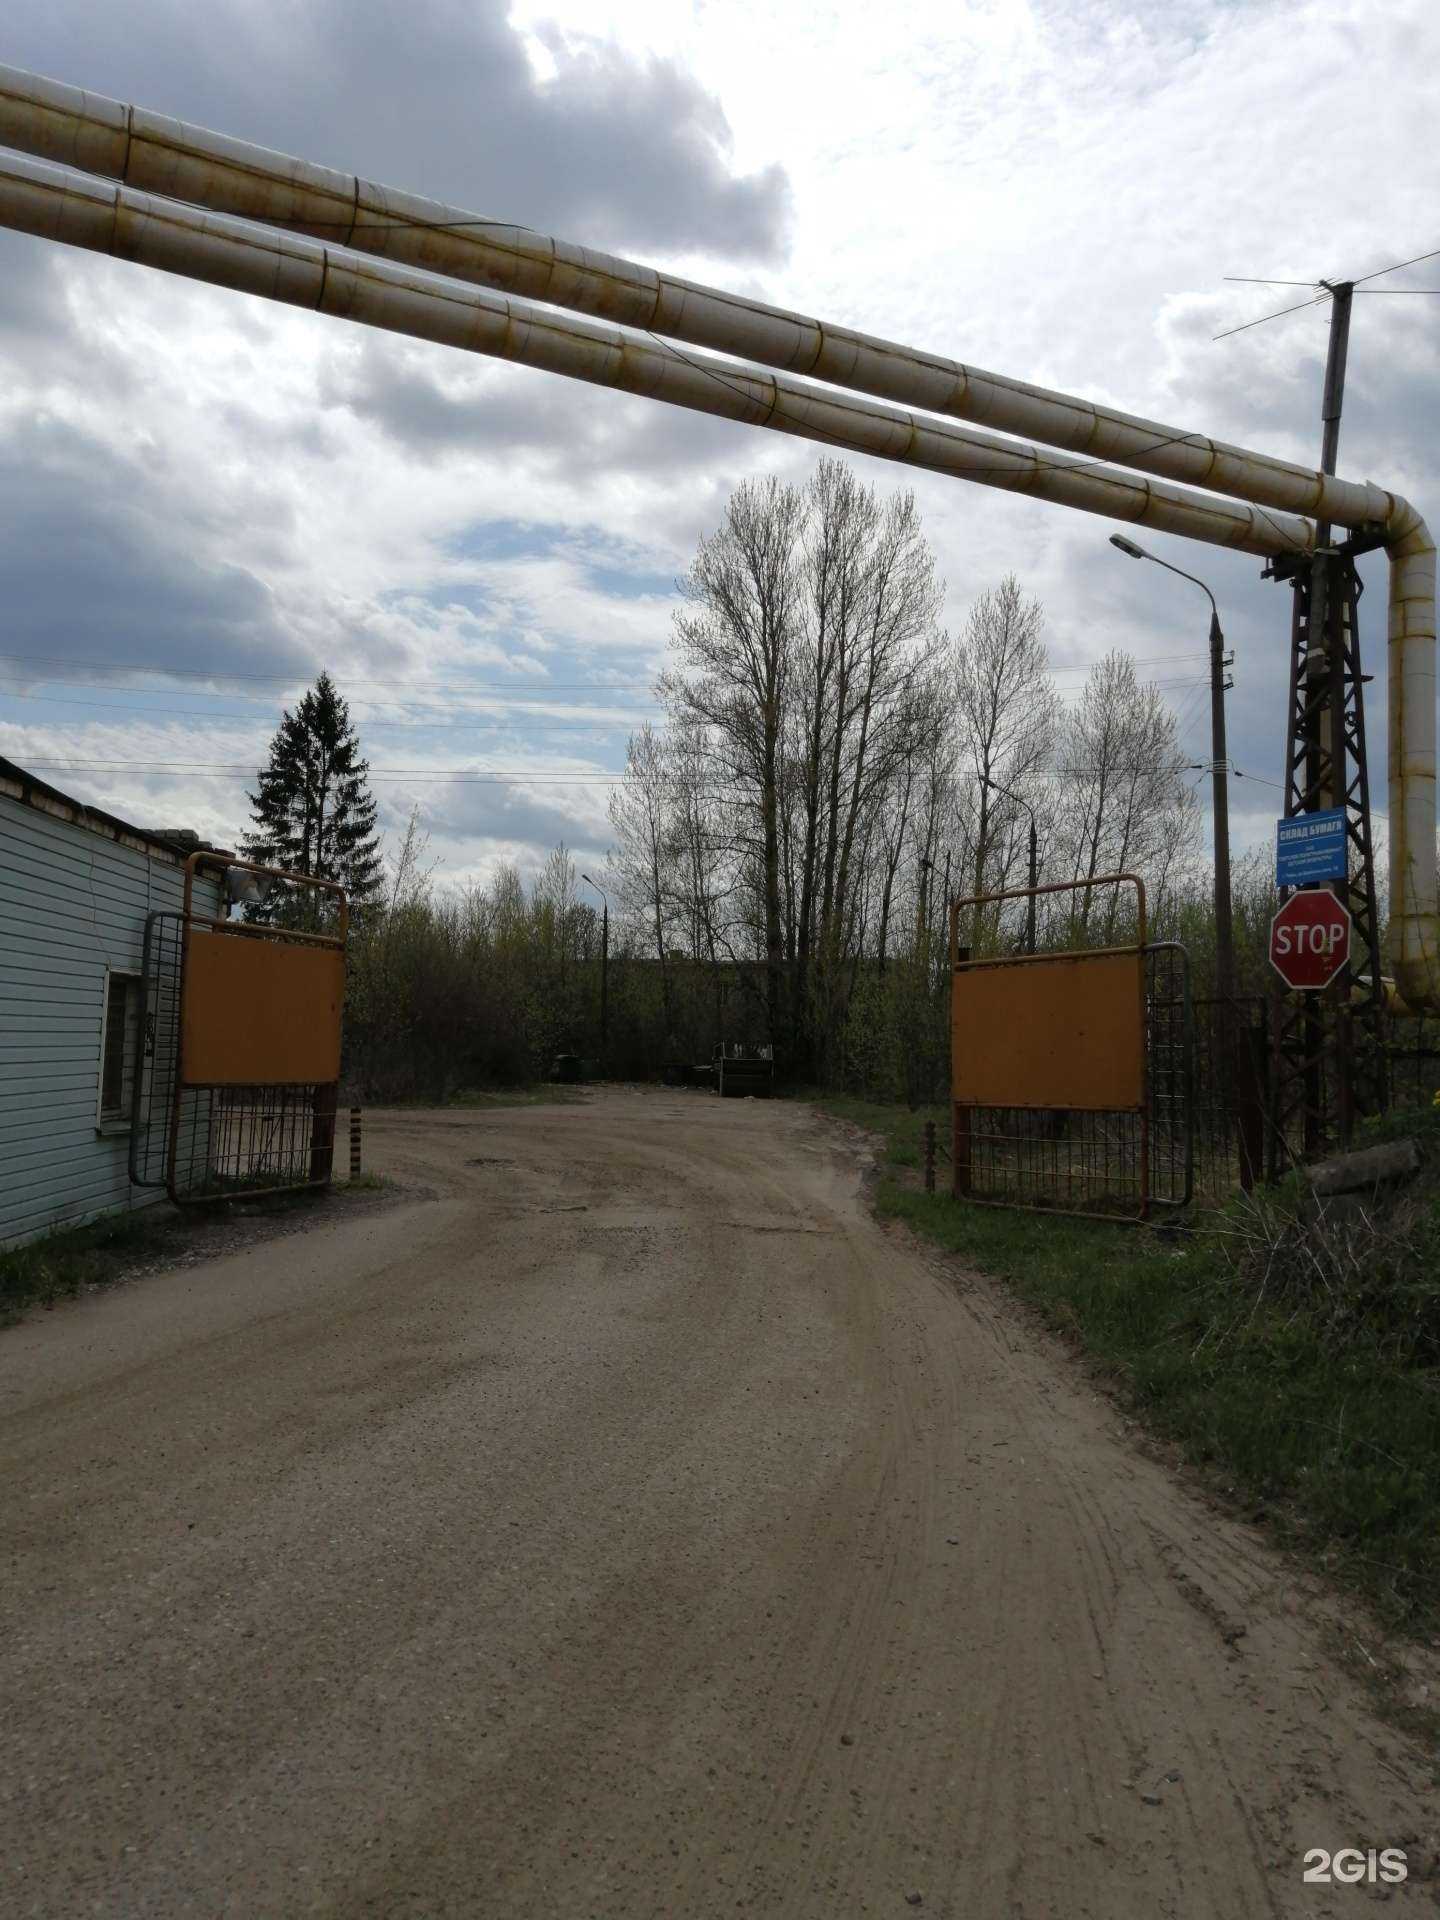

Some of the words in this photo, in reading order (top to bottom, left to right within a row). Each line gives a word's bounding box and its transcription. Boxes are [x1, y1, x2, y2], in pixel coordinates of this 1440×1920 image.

[1280, 827, 1309, 841] СКЛАД
[1310, 820, 1342, 835] БУМАГИ
[1276, 924, 1344, 954] STOP
